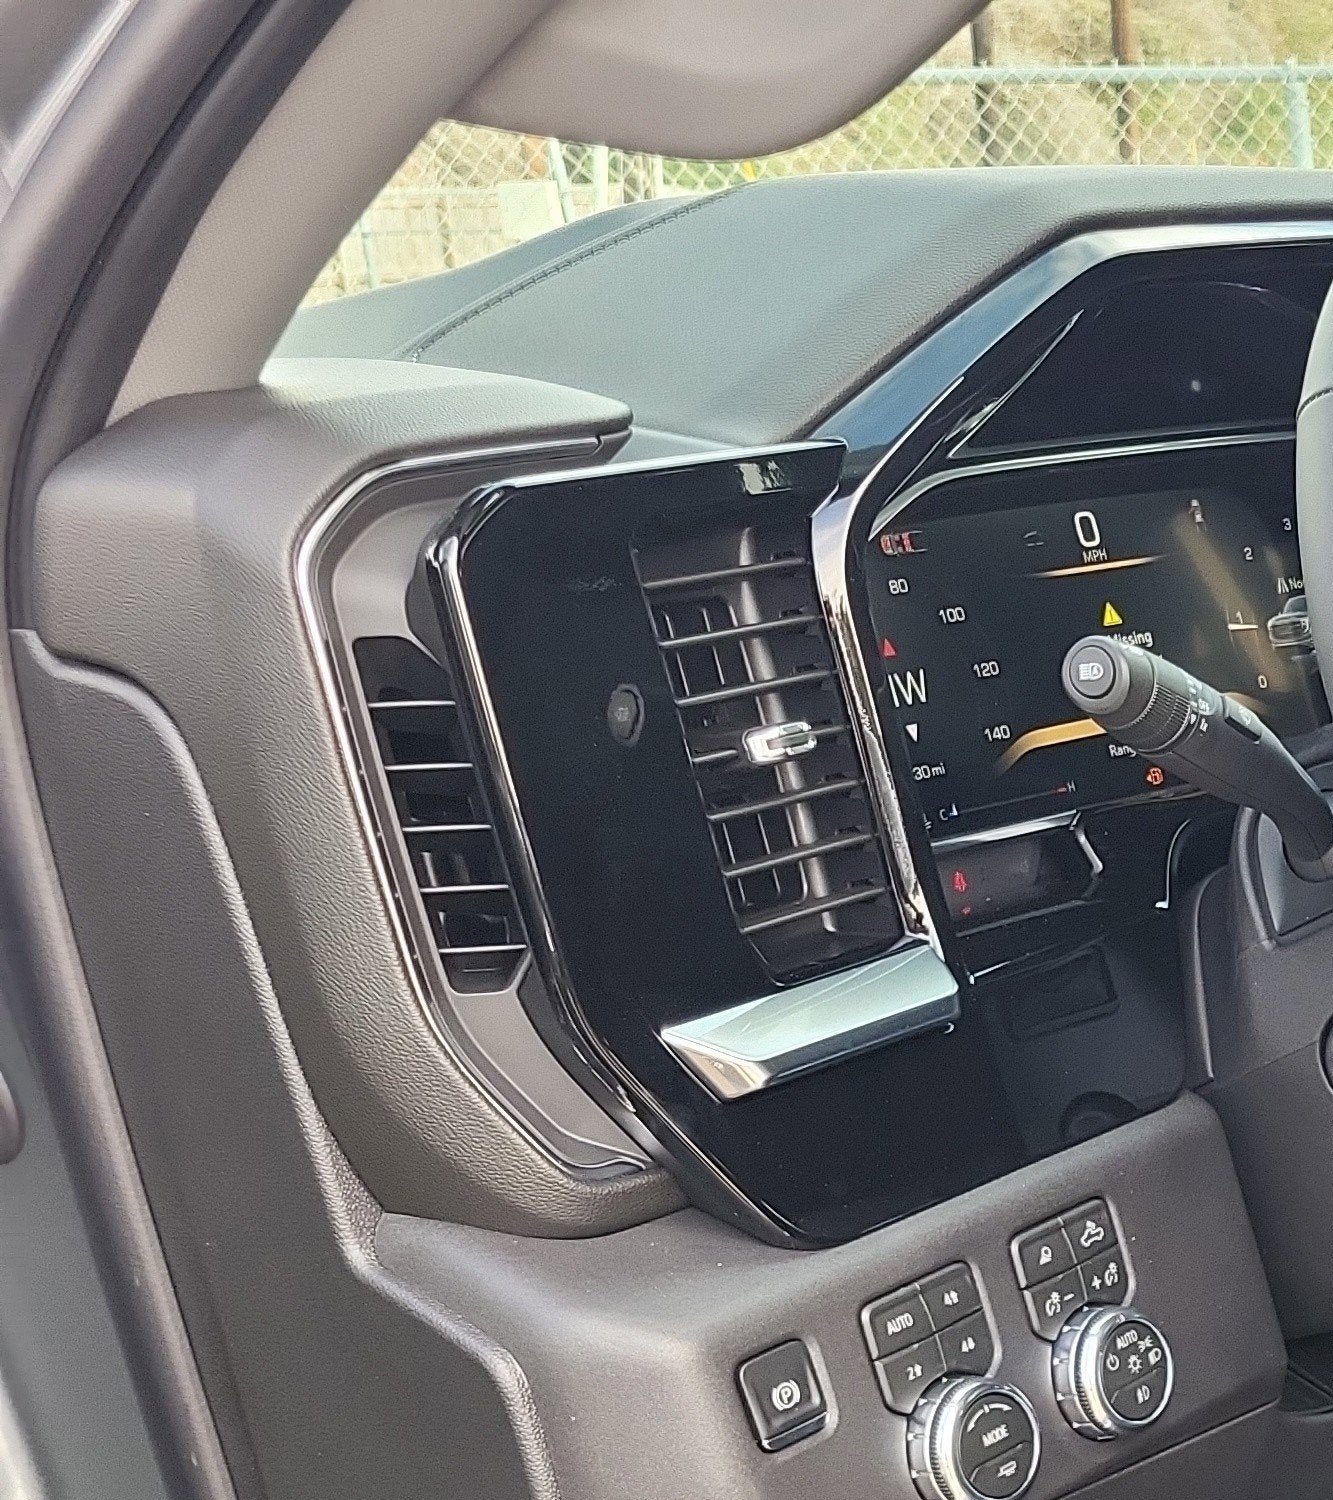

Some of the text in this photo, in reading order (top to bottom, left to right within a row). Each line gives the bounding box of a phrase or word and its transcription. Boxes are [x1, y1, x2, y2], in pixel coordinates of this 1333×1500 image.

[1073, 510, 1102, 549] 0
[1282, 517, 1293, 532] 3
[1082, 547, 1109, 564] MPH
[1243, 547, 1254, 561] 2
[888, 578, 909, 595] 80
[938, 606, 967, 625] 100
[972, 660, 1001, 679] 120
[1257, 674, 1269, 690] 0
[984, 724, 1012, 743] 140
[1066, 779, 1077, 793] H
[938, 808, 949, 822] C
[886, 1312, 914, 1337] AUTO
[1115, 1328, 1139, 1350] AUTO
[981, 1424, 1011, 1447] MODE
